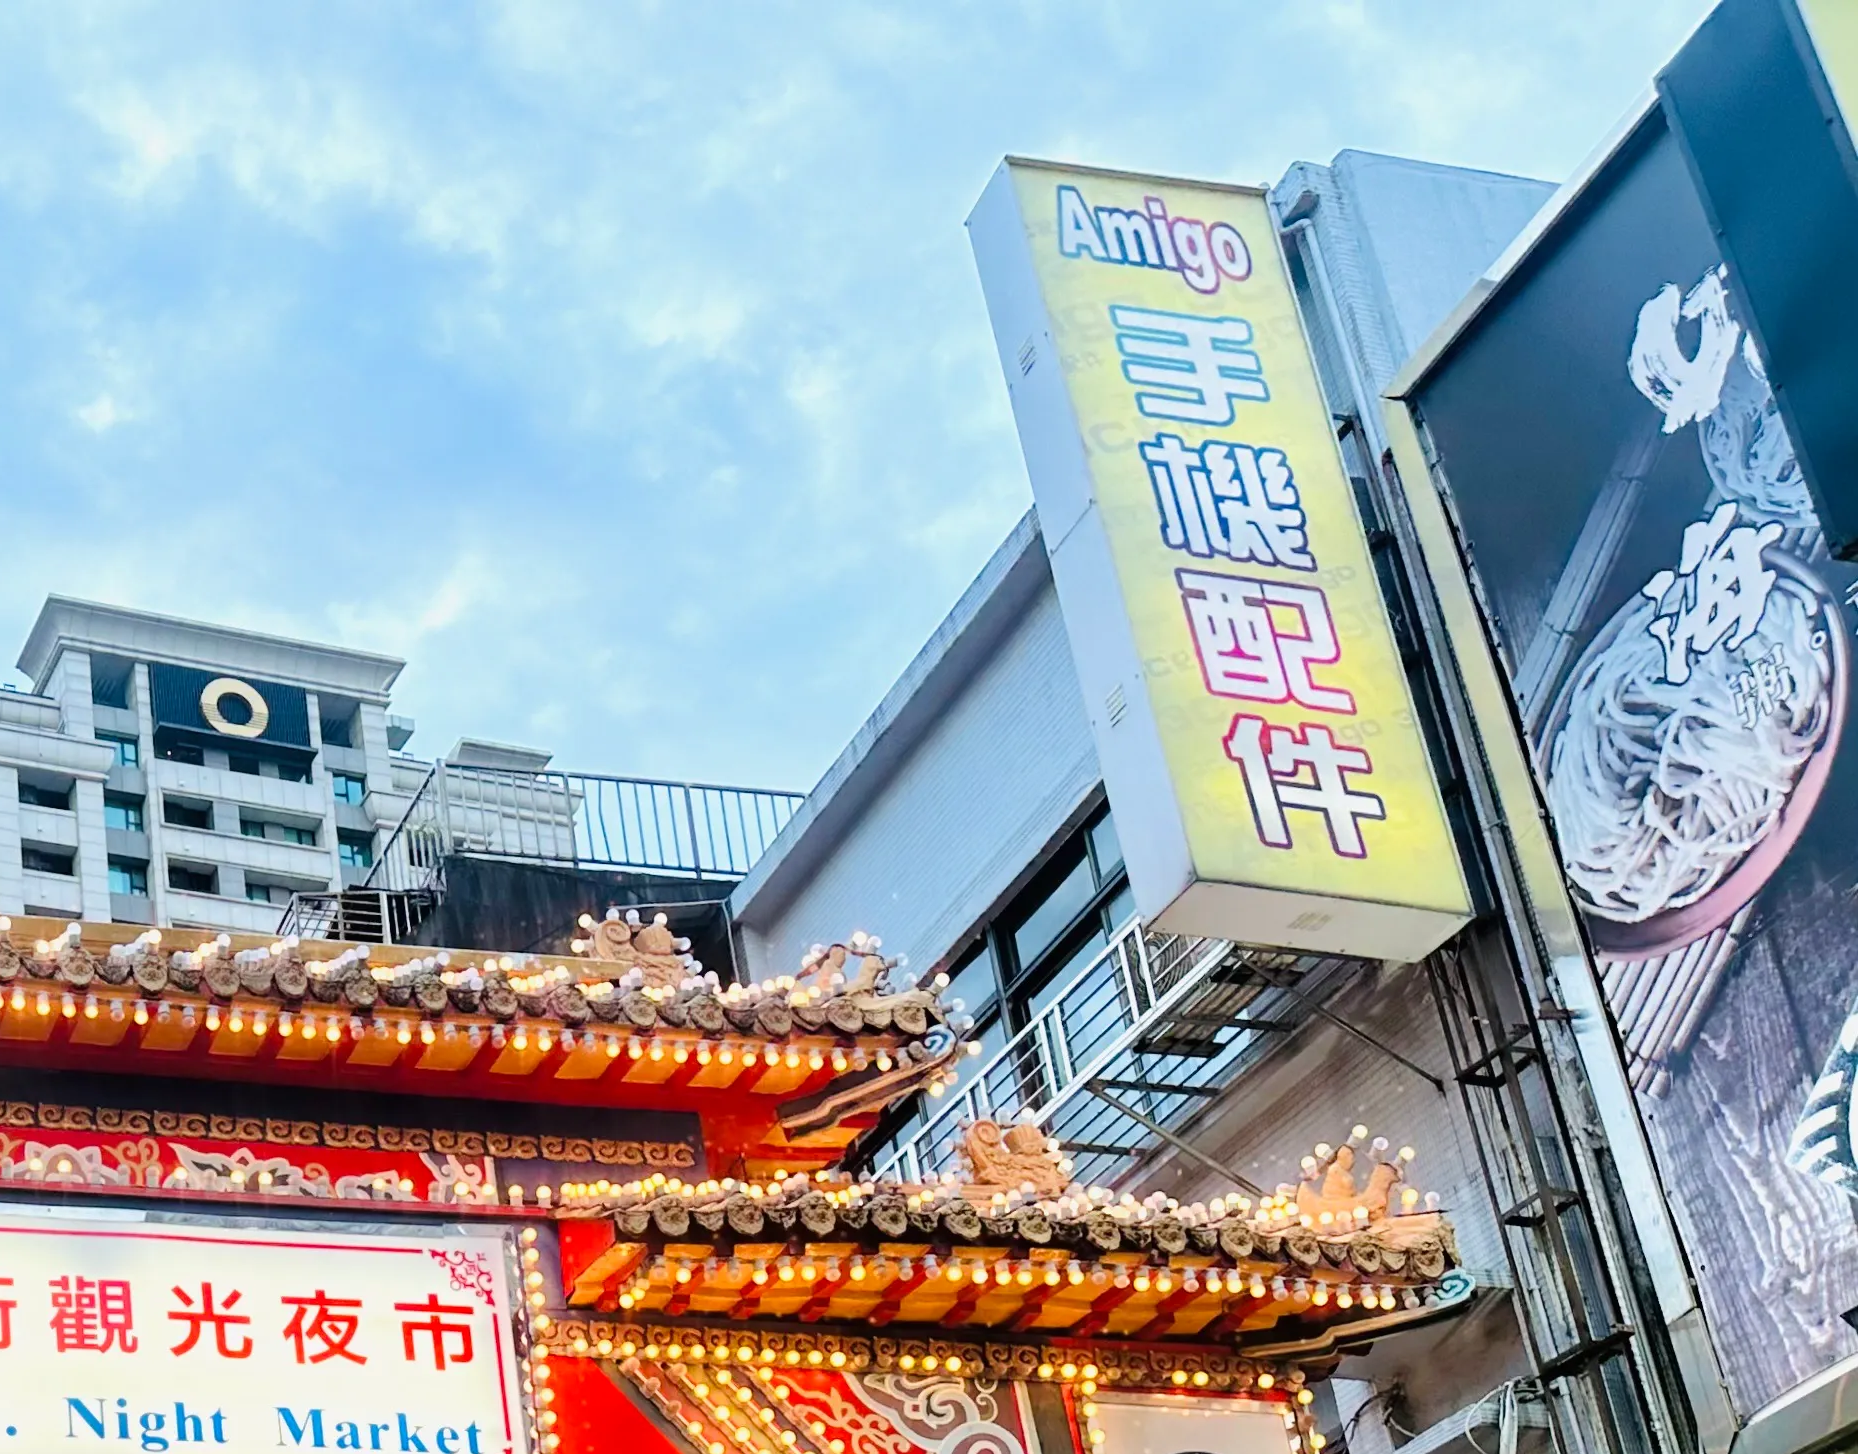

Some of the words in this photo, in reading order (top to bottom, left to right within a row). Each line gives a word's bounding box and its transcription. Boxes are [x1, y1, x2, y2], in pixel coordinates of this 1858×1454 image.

[1055, 184, 1252, 294] Amigo
[1109, 304, 1386, 859] 手機配件
[66, 1396, 229, 1453] Night
